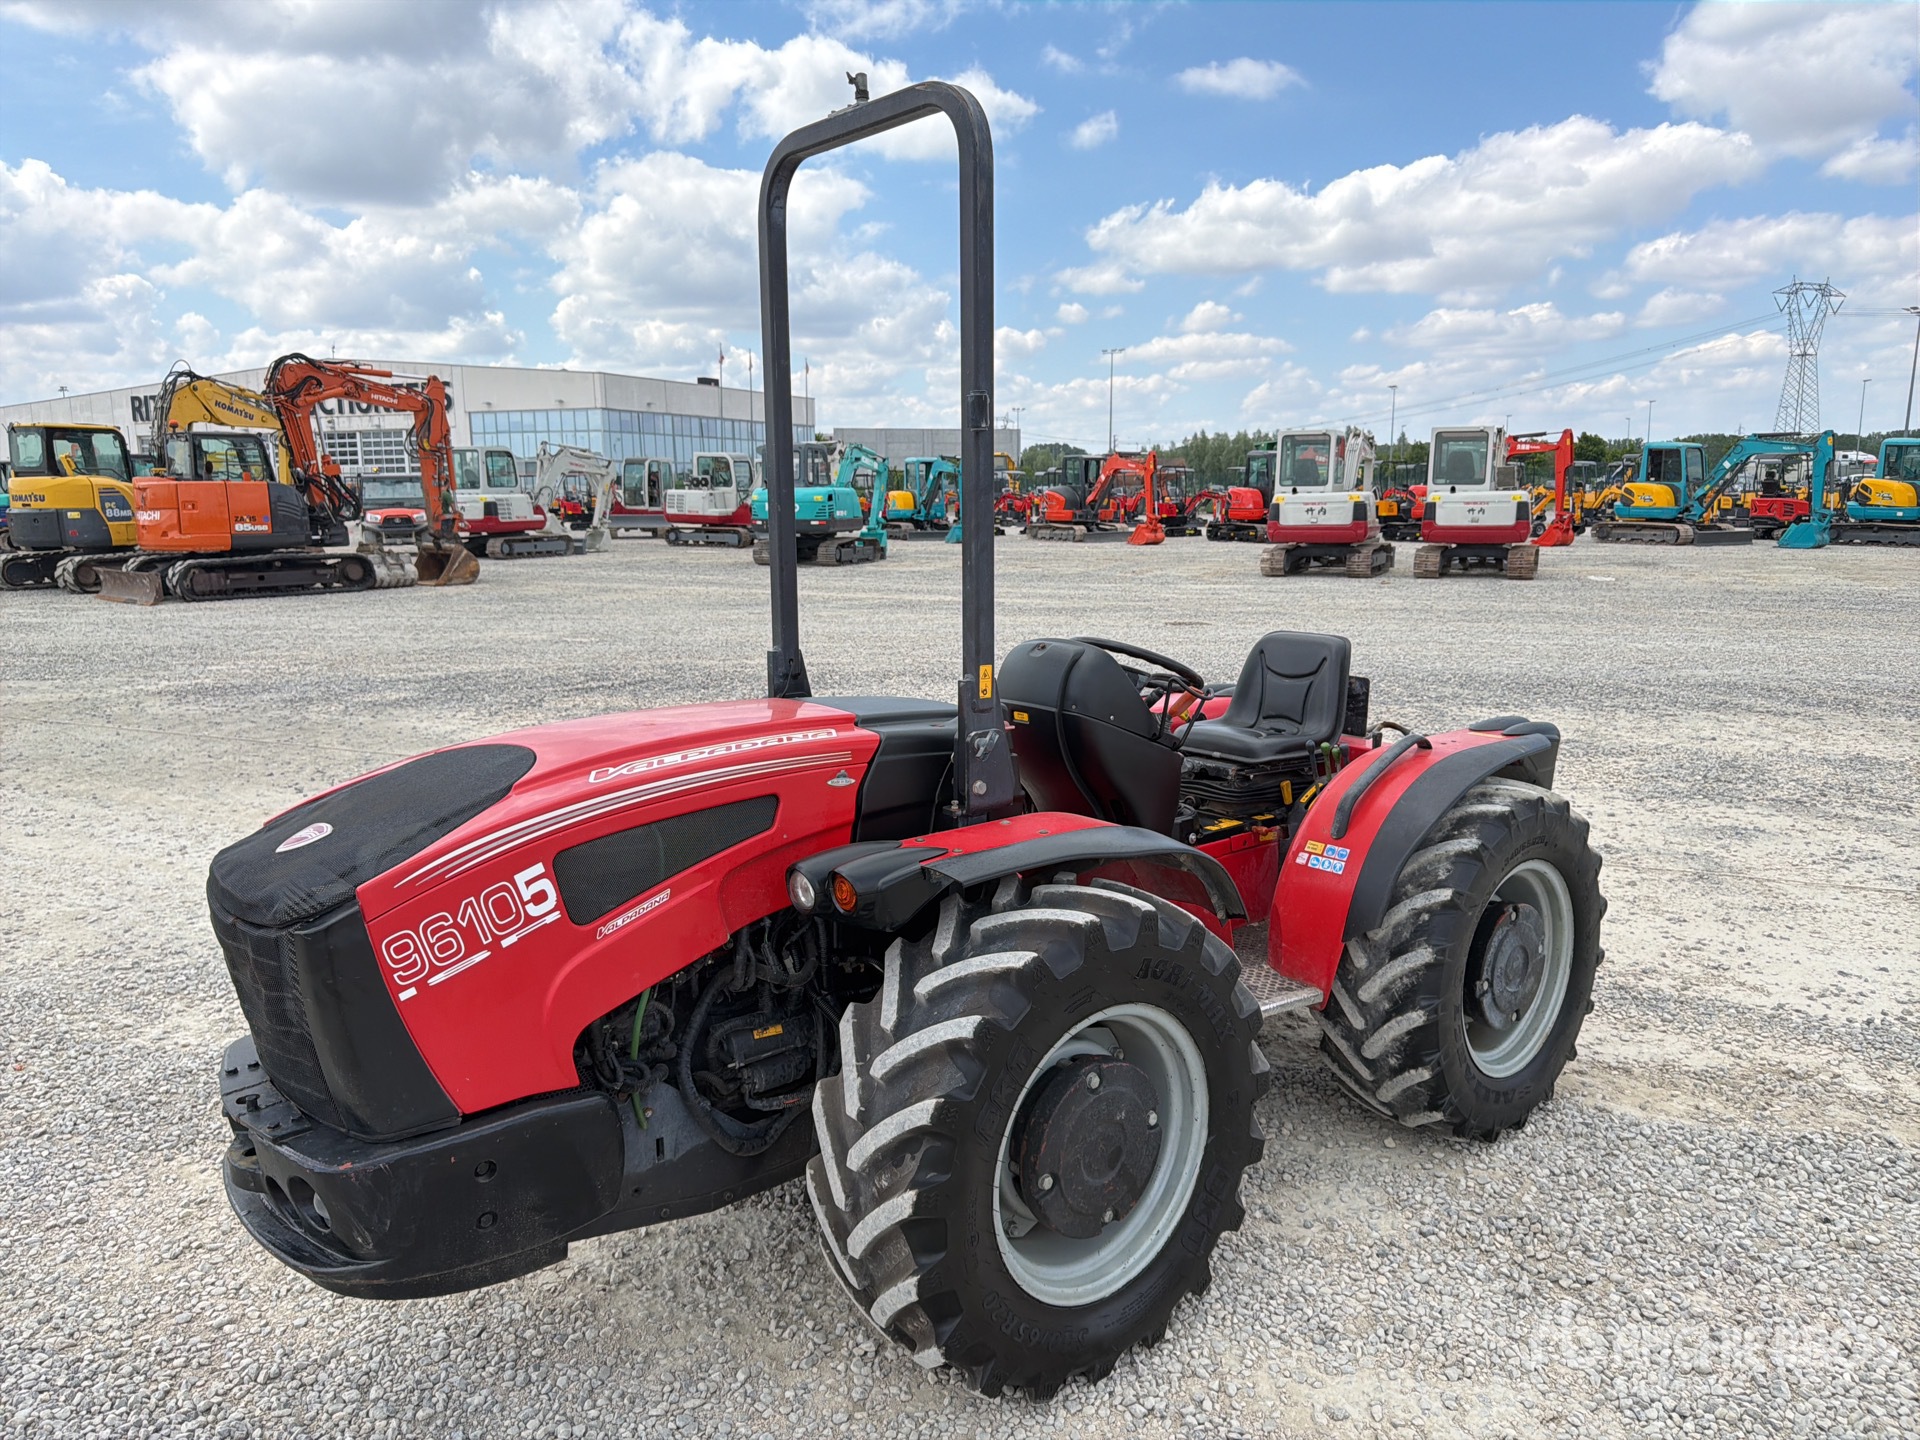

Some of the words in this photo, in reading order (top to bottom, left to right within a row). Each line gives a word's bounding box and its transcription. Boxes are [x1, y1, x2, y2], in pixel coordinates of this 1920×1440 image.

[371, 393, 399, 404] HITACHI
[214, 400, 254, 421] KOMATSU
[11, 493, 45, 502] KOMATSU
[105, 508, 133, 518] 88MR
[588, 728, 838, 784] VALPADANA
[596, 888, 671, 940] VALPADANA
